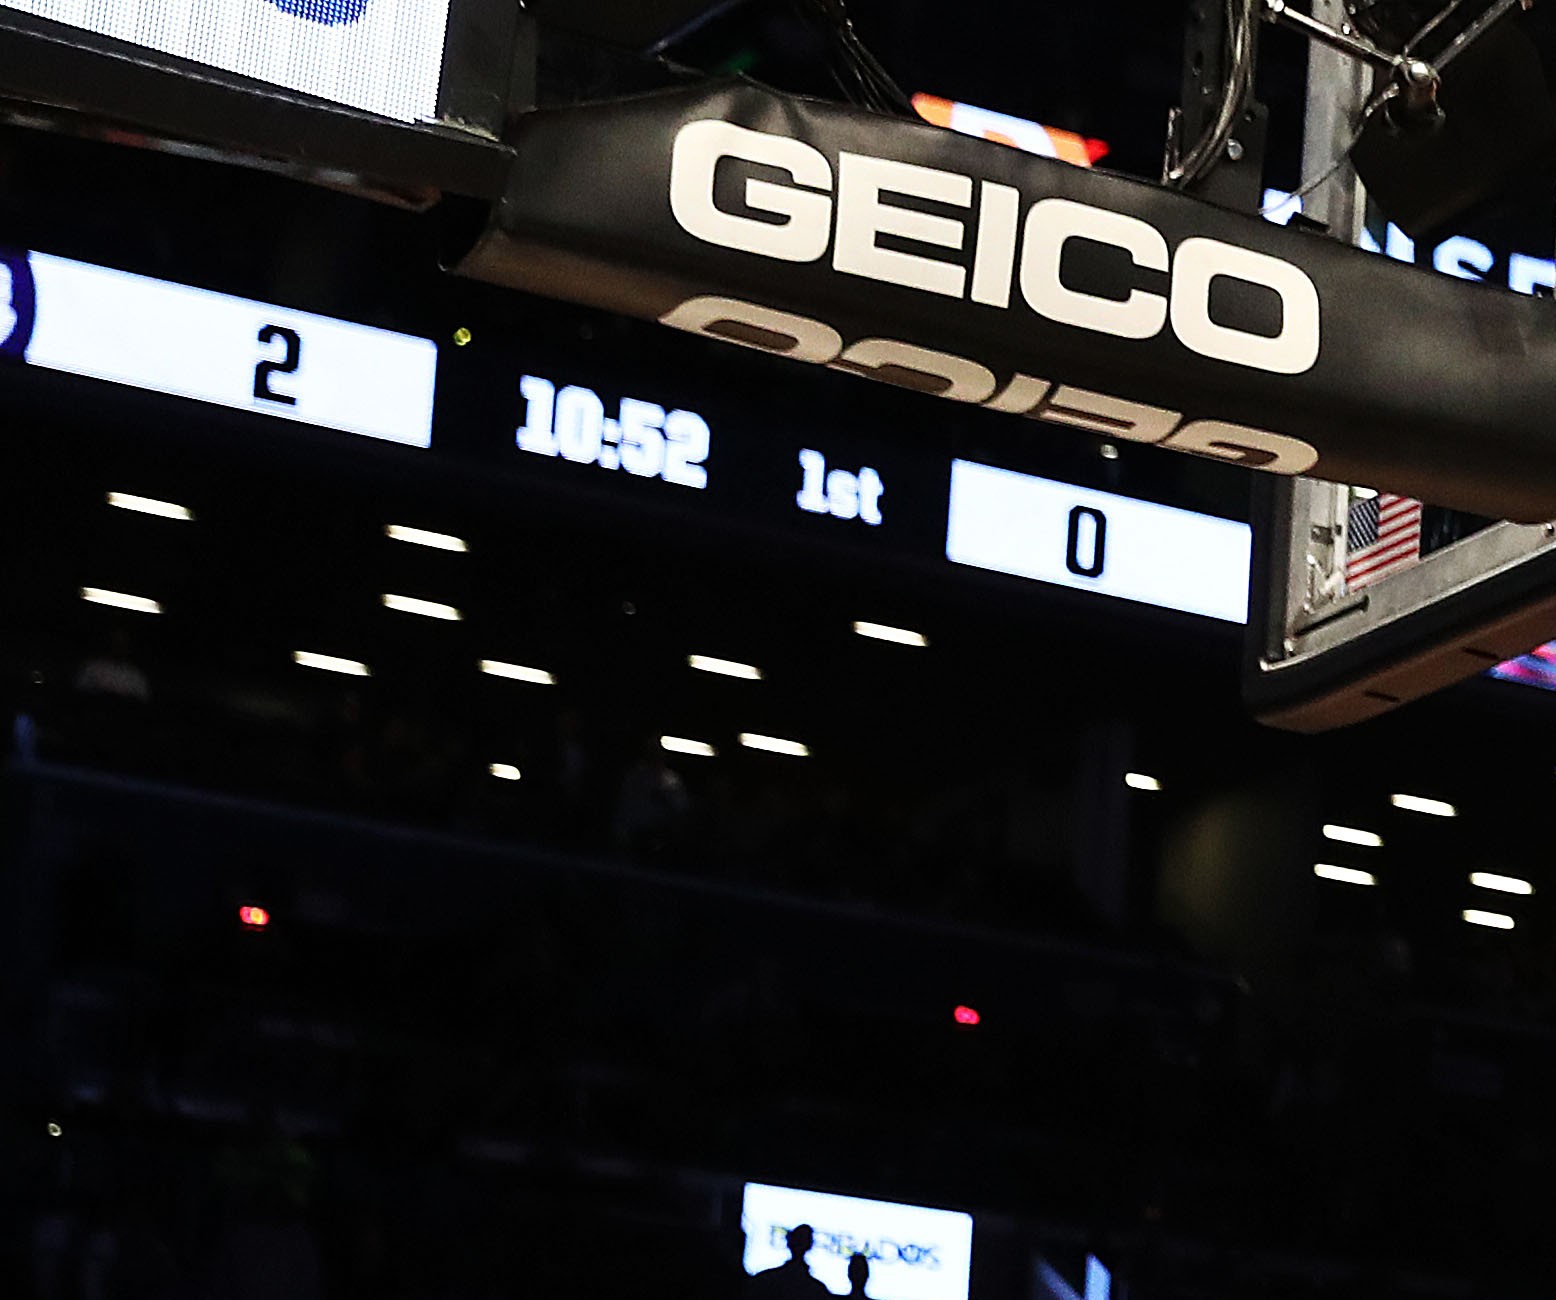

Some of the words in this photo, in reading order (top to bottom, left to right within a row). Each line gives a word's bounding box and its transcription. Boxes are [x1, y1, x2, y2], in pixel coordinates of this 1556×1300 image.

[669, 118, 1321, 375] GEICO
[253, 324, 302, 406] 2
[516, 374, 711, 490] 10:52
[797, 448, 884, 526] 1st
[1065, 504, 1107, 579] 0
